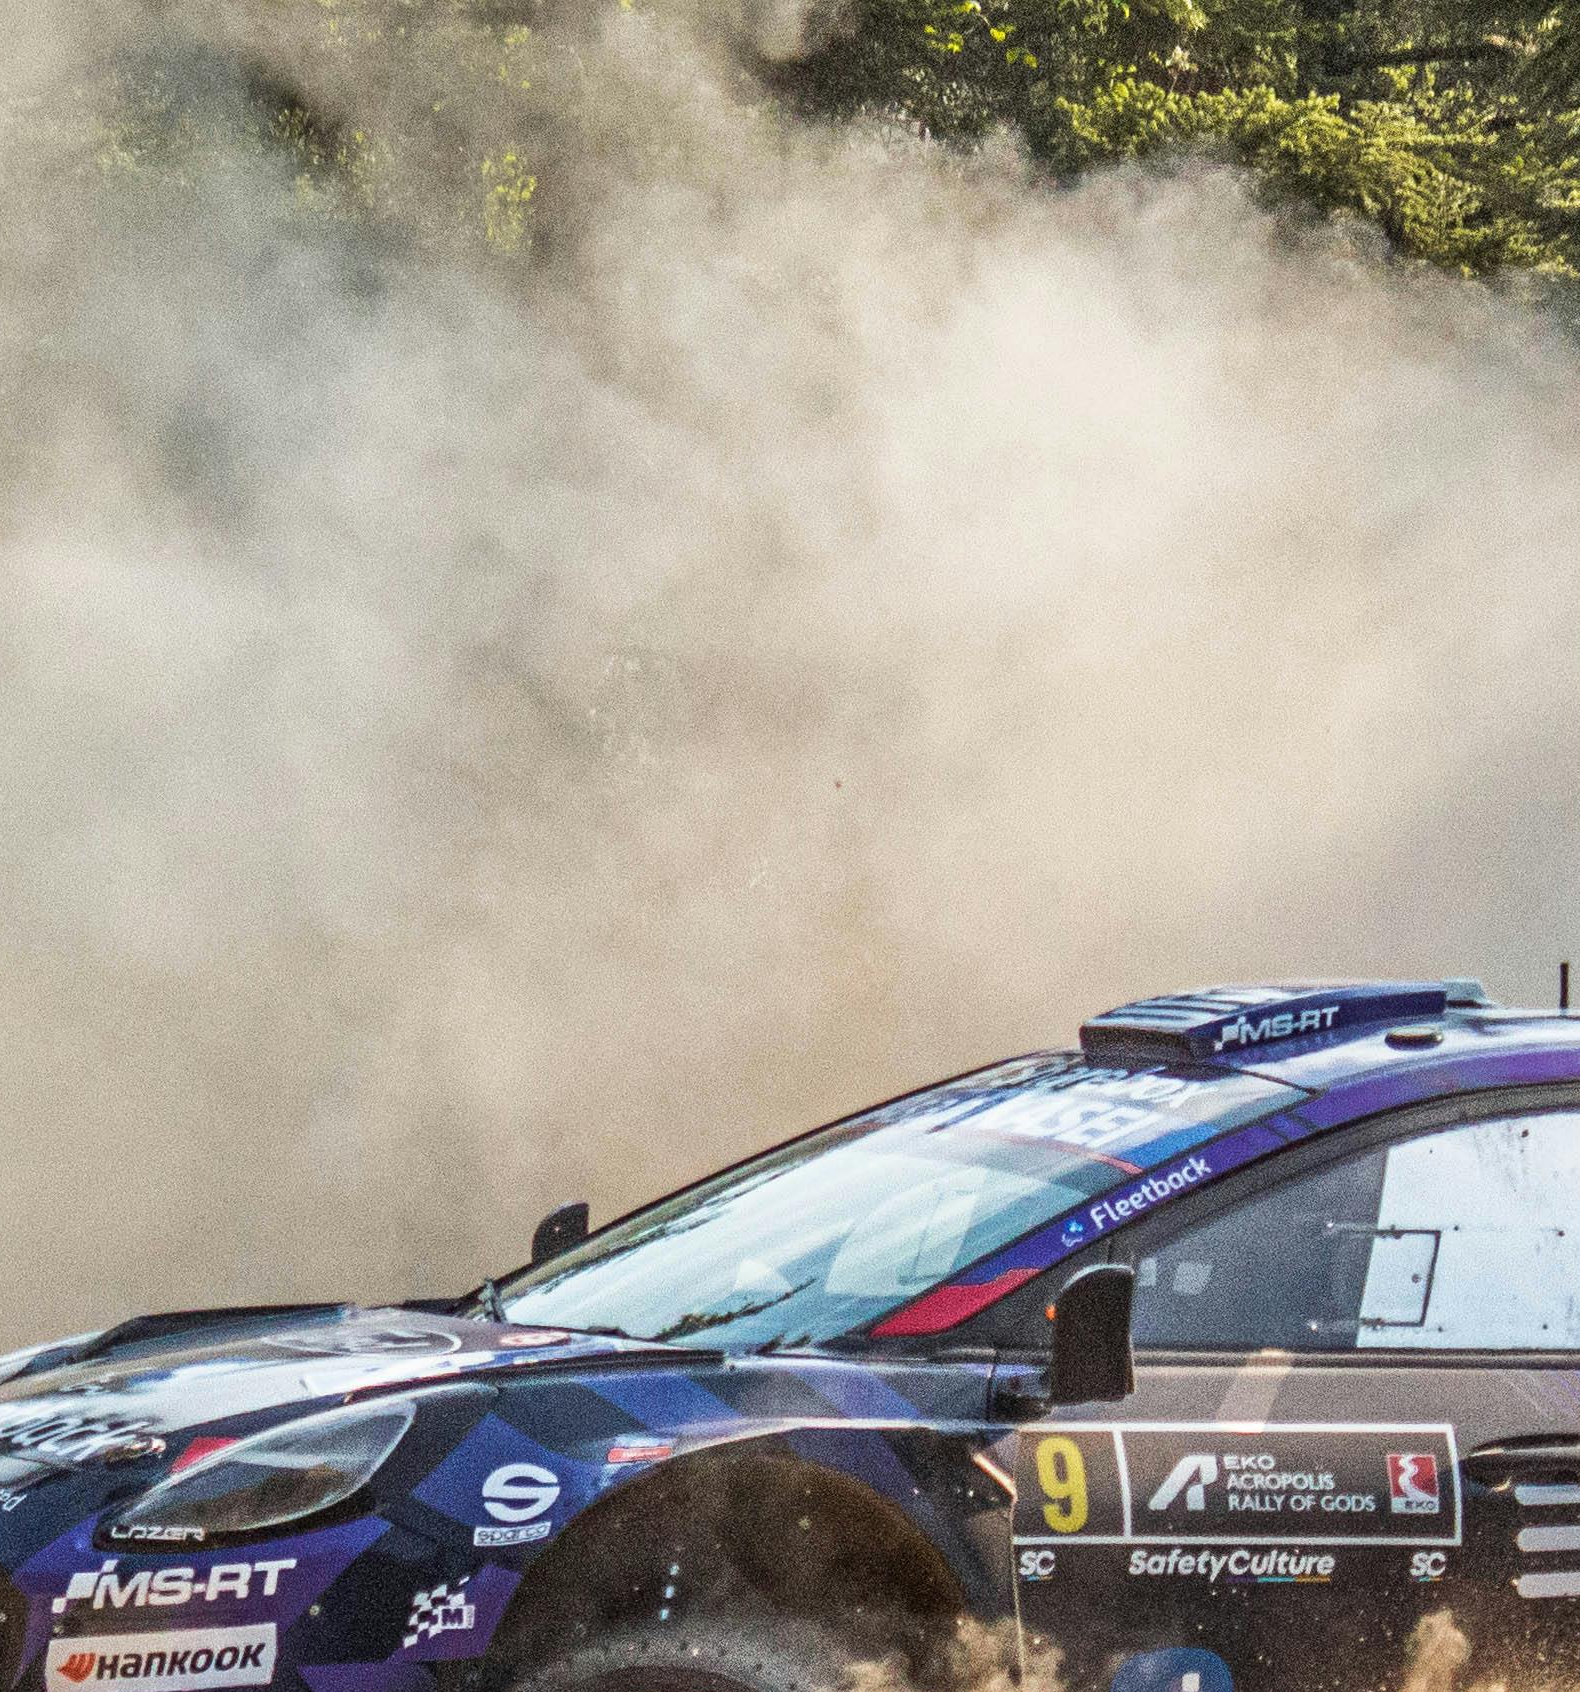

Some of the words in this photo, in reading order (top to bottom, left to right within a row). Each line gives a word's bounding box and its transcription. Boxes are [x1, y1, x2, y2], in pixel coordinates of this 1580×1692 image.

[1239, 1006, 1340, 1044] MS-RT
[1089, 1157, 1212, 1230] Fleetback
[1223, 1455, 1275, 1470] EKO
[1036, 1436, 1089, 1533] 9
[1226, 1473, 1335, 1491] ACROPOLIS
[1228, 1494, 1287, 1512] RALLY
[1289, 1495, 1316, 1512] OF
[1320, 1494, 1376, 1512] GODS
[111, 1526, 204, 1542] LAZER
[477, 1524, 549, 1543] sparco
[1020, 1550, 1056, 1576] SC
[1128, 1549, 1336, 1583] SafetyCulture
[1409, 1551, 1447, 1576] SC
[93, 1559, 297, 1609] MS-RT
